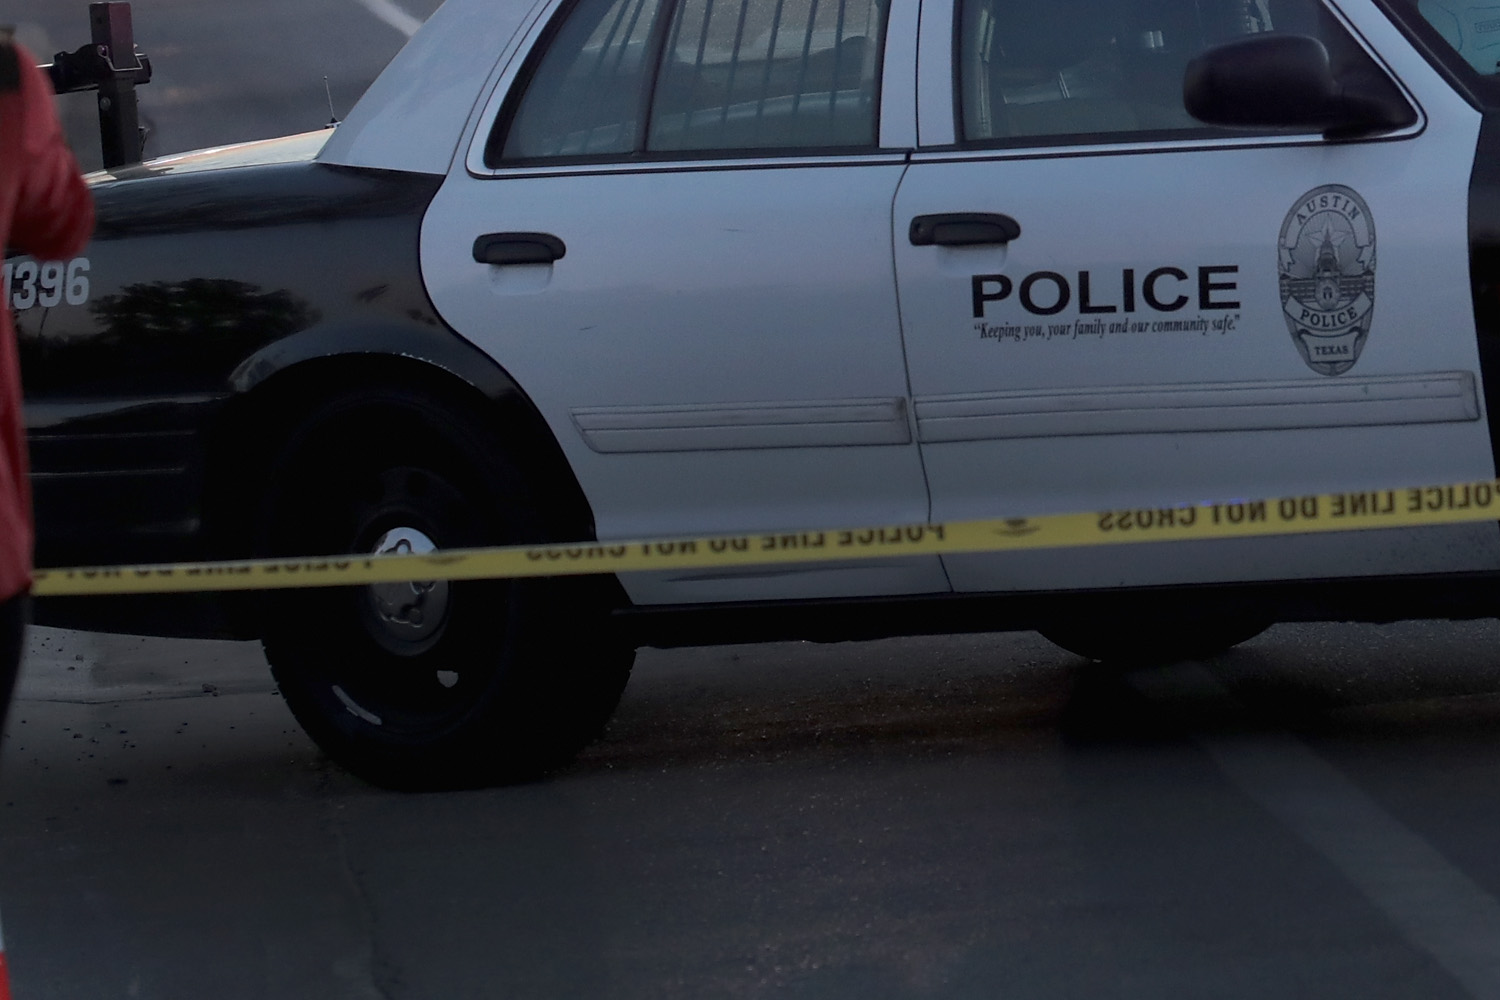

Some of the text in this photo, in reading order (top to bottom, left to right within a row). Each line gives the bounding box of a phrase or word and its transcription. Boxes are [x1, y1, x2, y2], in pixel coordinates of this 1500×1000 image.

[1297, 195, 1361, 225] AUSTIN
[972, 265, 1240, 318] POLICE
[1023, 324, 1046, 341] you,
[1047, 324, 1071, 340] your
[1073, 319, 1107, 339] family
[1109, 317, 1128, 334] and
[1131, 321, 1149, 333] our
[1152, 315, 1208, 335] community
[1300, 306, 1357, 328] POLICE
[1313, 345, 1349, 355] TEXAS
